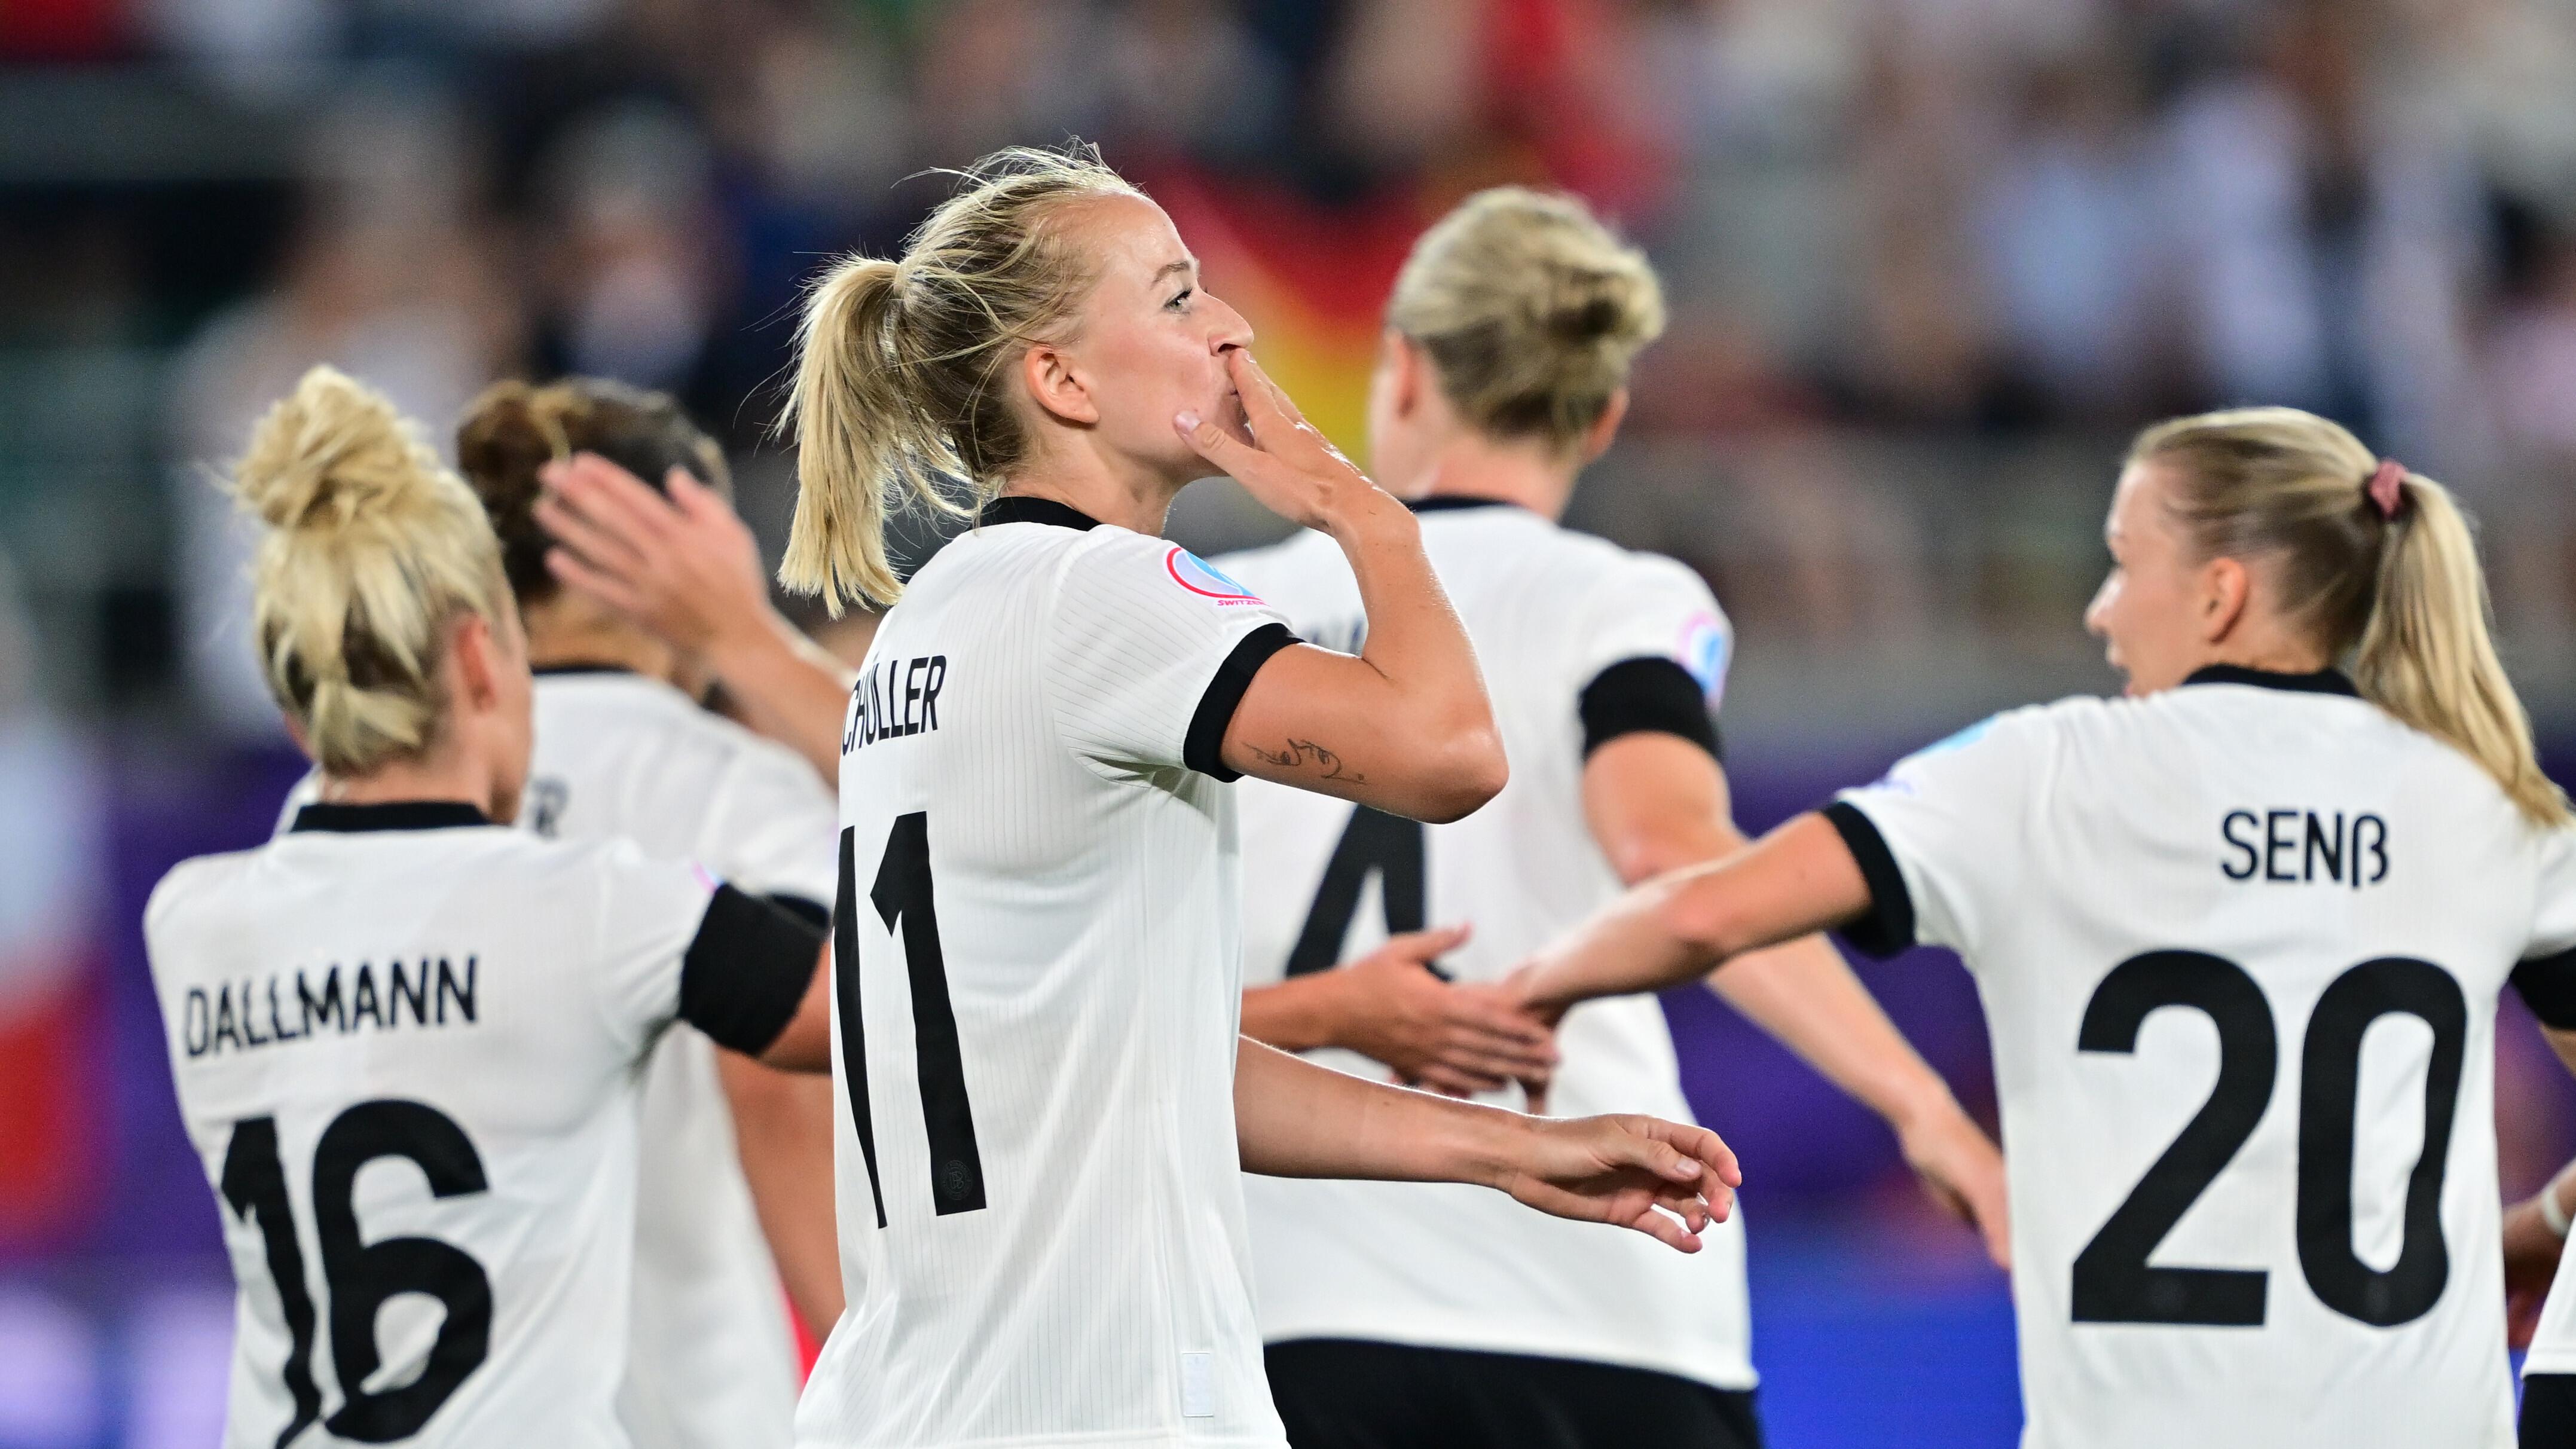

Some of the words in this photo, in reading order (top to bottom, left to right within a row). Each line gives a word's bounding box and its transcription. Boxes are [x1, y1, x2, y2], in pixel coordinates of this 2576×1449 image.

[842, 654, 947, 757] CHÜLLER
[2221, 810, 2388, 888] SENß
[186, 955, 478, 1057] DALLMANN
[833, 810, 987, 1230] 11
[2071, 948, 2468, 1327] 20
[221, 1099, 494, 1449] 16
